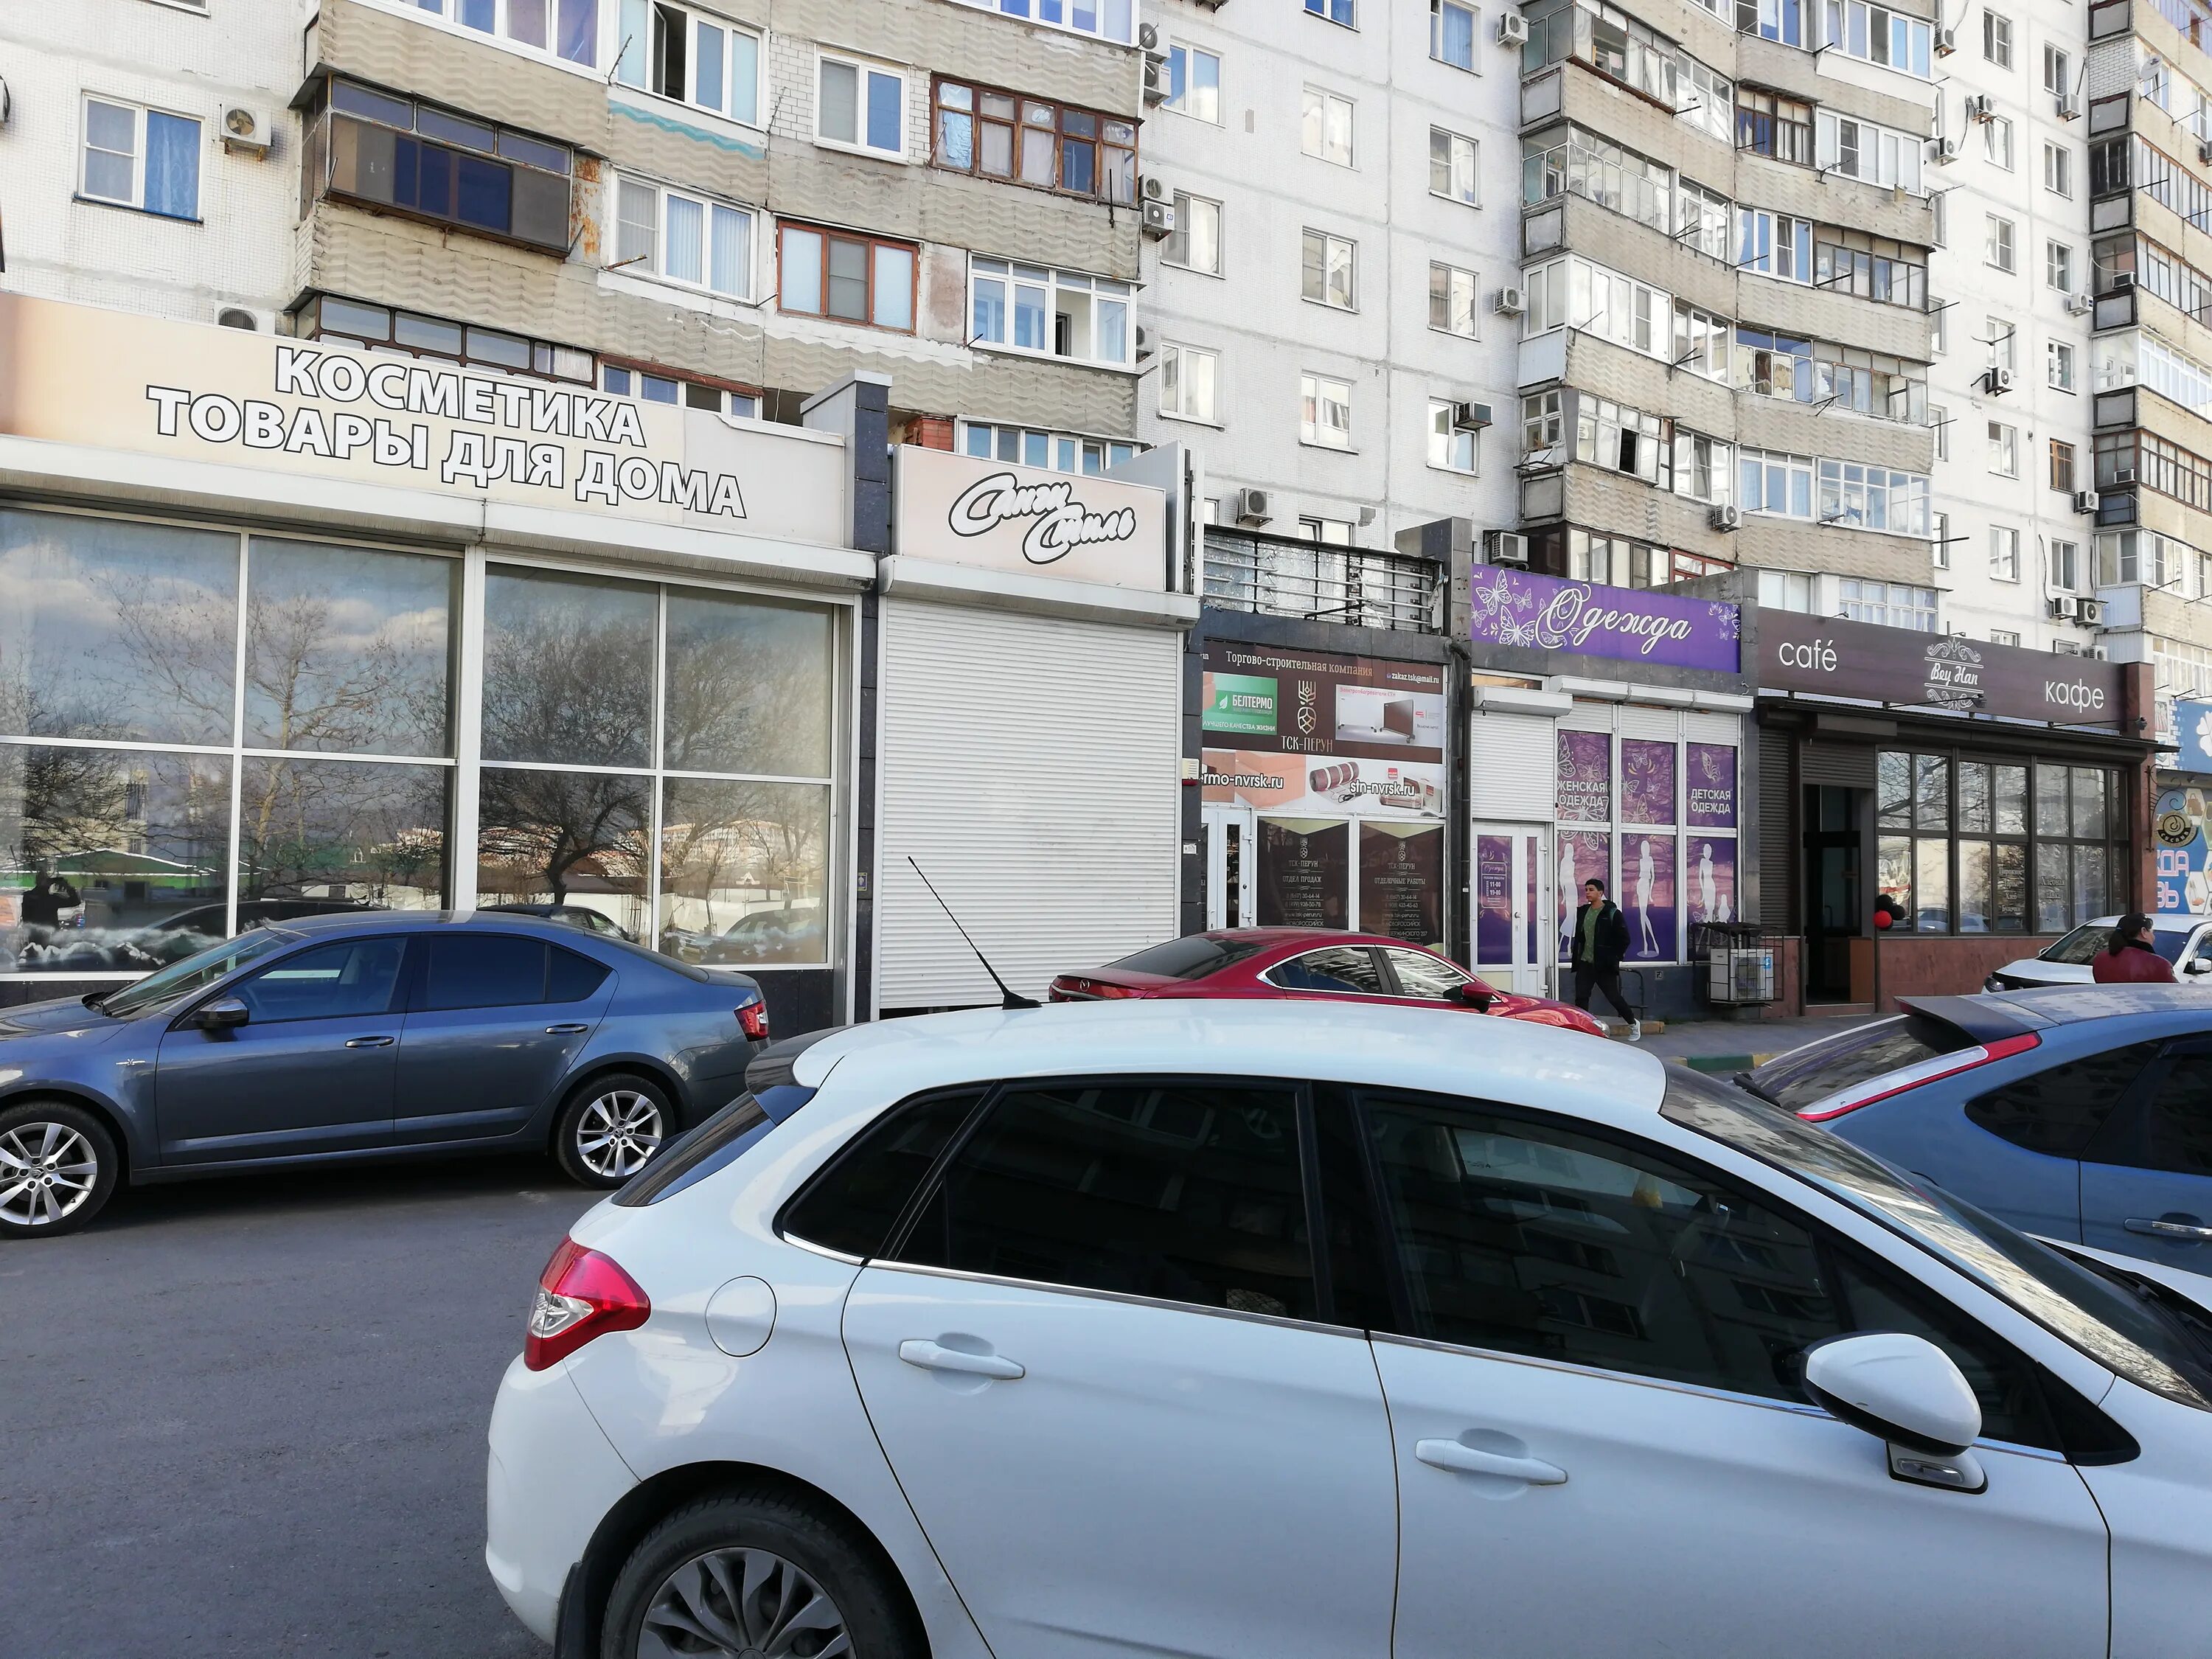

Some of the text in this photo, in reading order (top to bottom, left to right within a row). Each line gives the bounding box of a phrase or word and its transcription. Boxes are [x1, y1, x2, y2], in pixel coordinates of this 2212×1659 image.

[275, 344, 647, 448] КОСМЕТИКА
[146, 384, 748, 519] ТОВАРЫ ДЛЯ ДОМА
[1535, 583, 1692, 655] Одежда
[1778, 639, 1837, 672] café
[1225, 651, 1374, 677] Торгово-строительная компания
[1391, 672, 1439, 684] zakaz.tsk@mail.ru
[1930, 662, 1978, 686] Bey Han
[1232, 694, 1273, 709] БЕЛТЕРМО
[2045, 679, 2104, 713] кафе
[1229, 722, 1256, 731] КАЧЕСТВА
[1256, 724, 1276, 732] ЖИЗНИ
[1281, 735, 1333, 754] ТСК-ПЕРУН
[1349, 779, 1416, 797] stn-nvrsk.ru
[1557, 780, 1606, 793] ЖЕНСКАЯ
[1559, 794, 1604, 808] ОДЕЖДА
[1690, 788, 1731, 801] ДЕТСКАЯ
[1691, 801, 1731, 815] ОДЕЖДА
[1289, 860, 1318, 868] ТСК-ПЕРУН
[1282, 875, 1322, 884] ОТДЕЛ ПРОДАЖ
[1374, 877, 1406, 885] ОТДЕЛОЧНЫЕ
